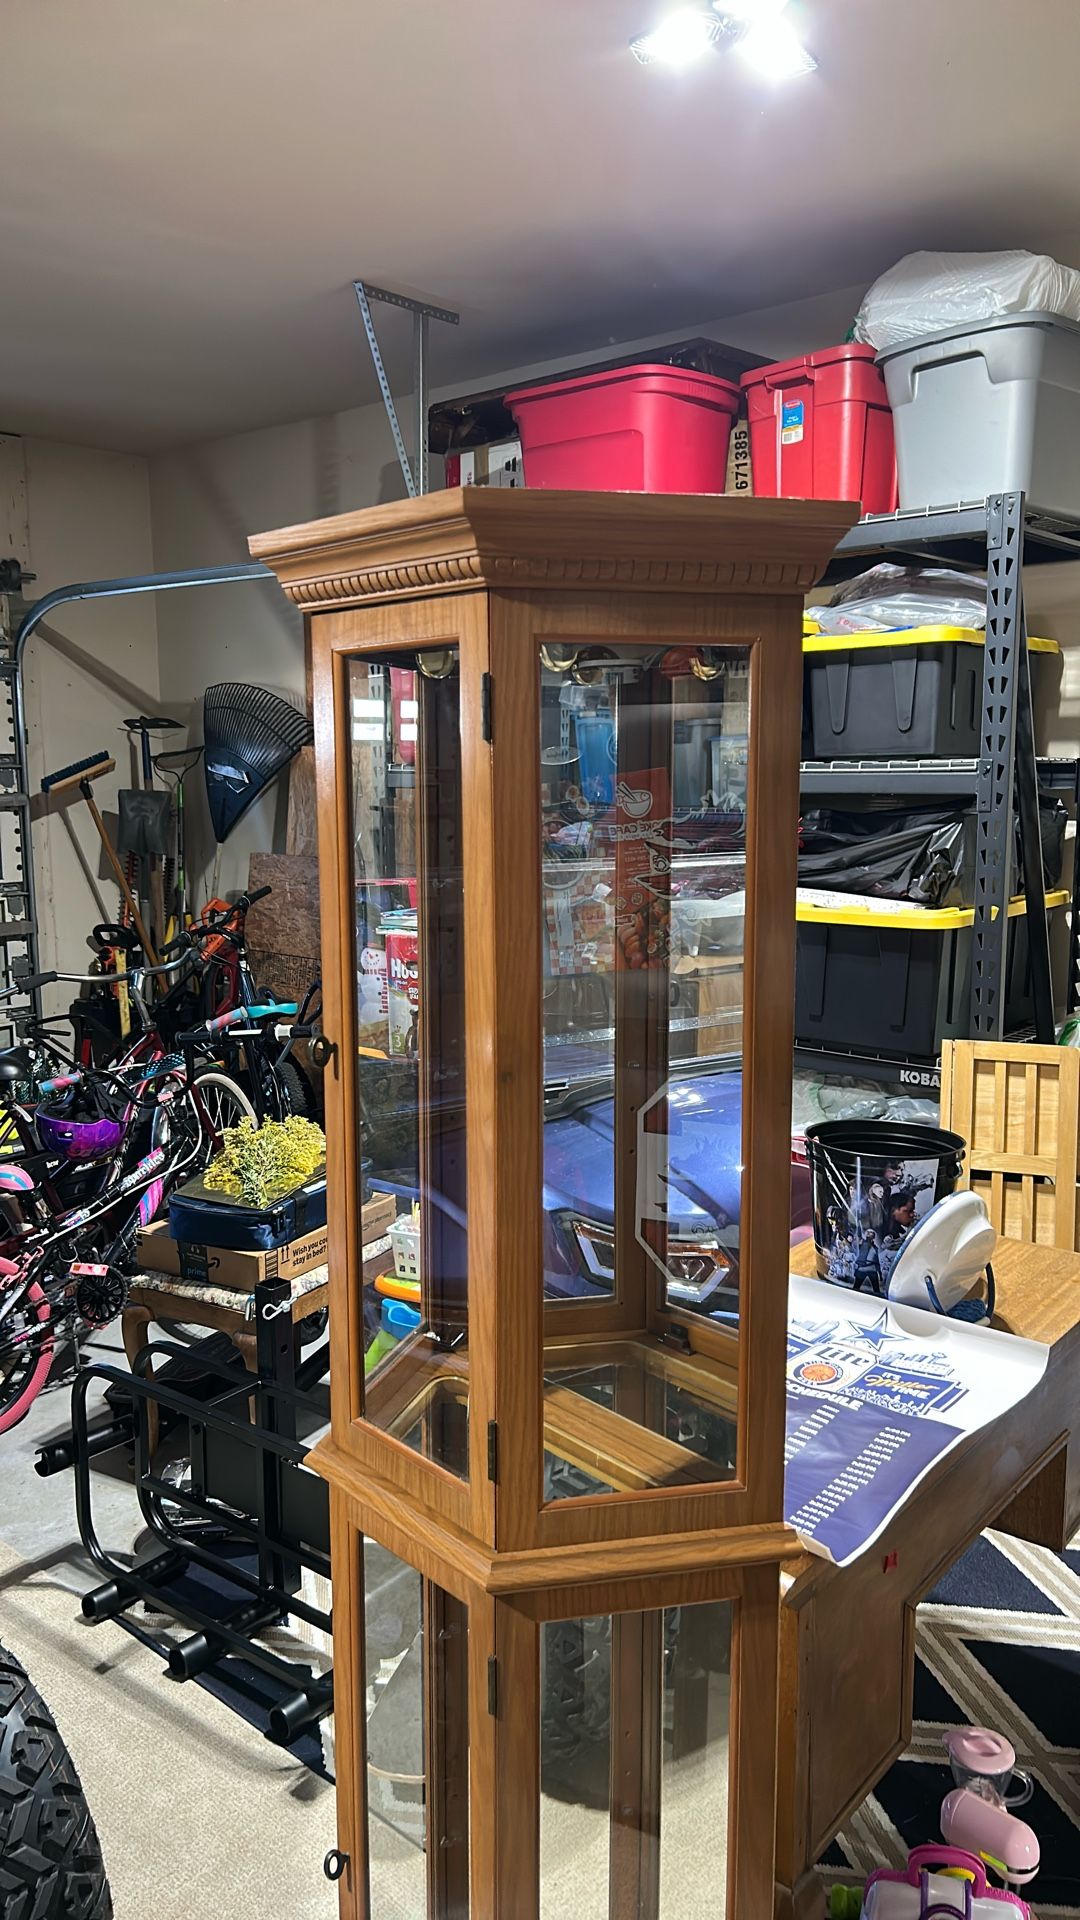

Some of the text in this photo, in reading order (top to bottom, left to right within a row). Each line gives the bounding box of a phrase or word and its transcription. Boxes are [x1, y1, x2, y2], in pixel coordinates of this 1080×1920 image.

[734, 431, 749, 490] 671385
[394, 1034, 402, 1048] 3
[292, 1245, 308, 1257] Wish
[308, 1241, 319, 1252] you
[292, 1245, 327, 1267] stay in bed?
[814, 1346, 871, 1367] Lite
[864, 1374, 940, 1390] Miller
[891, 1385, 931, 1400] TIME
